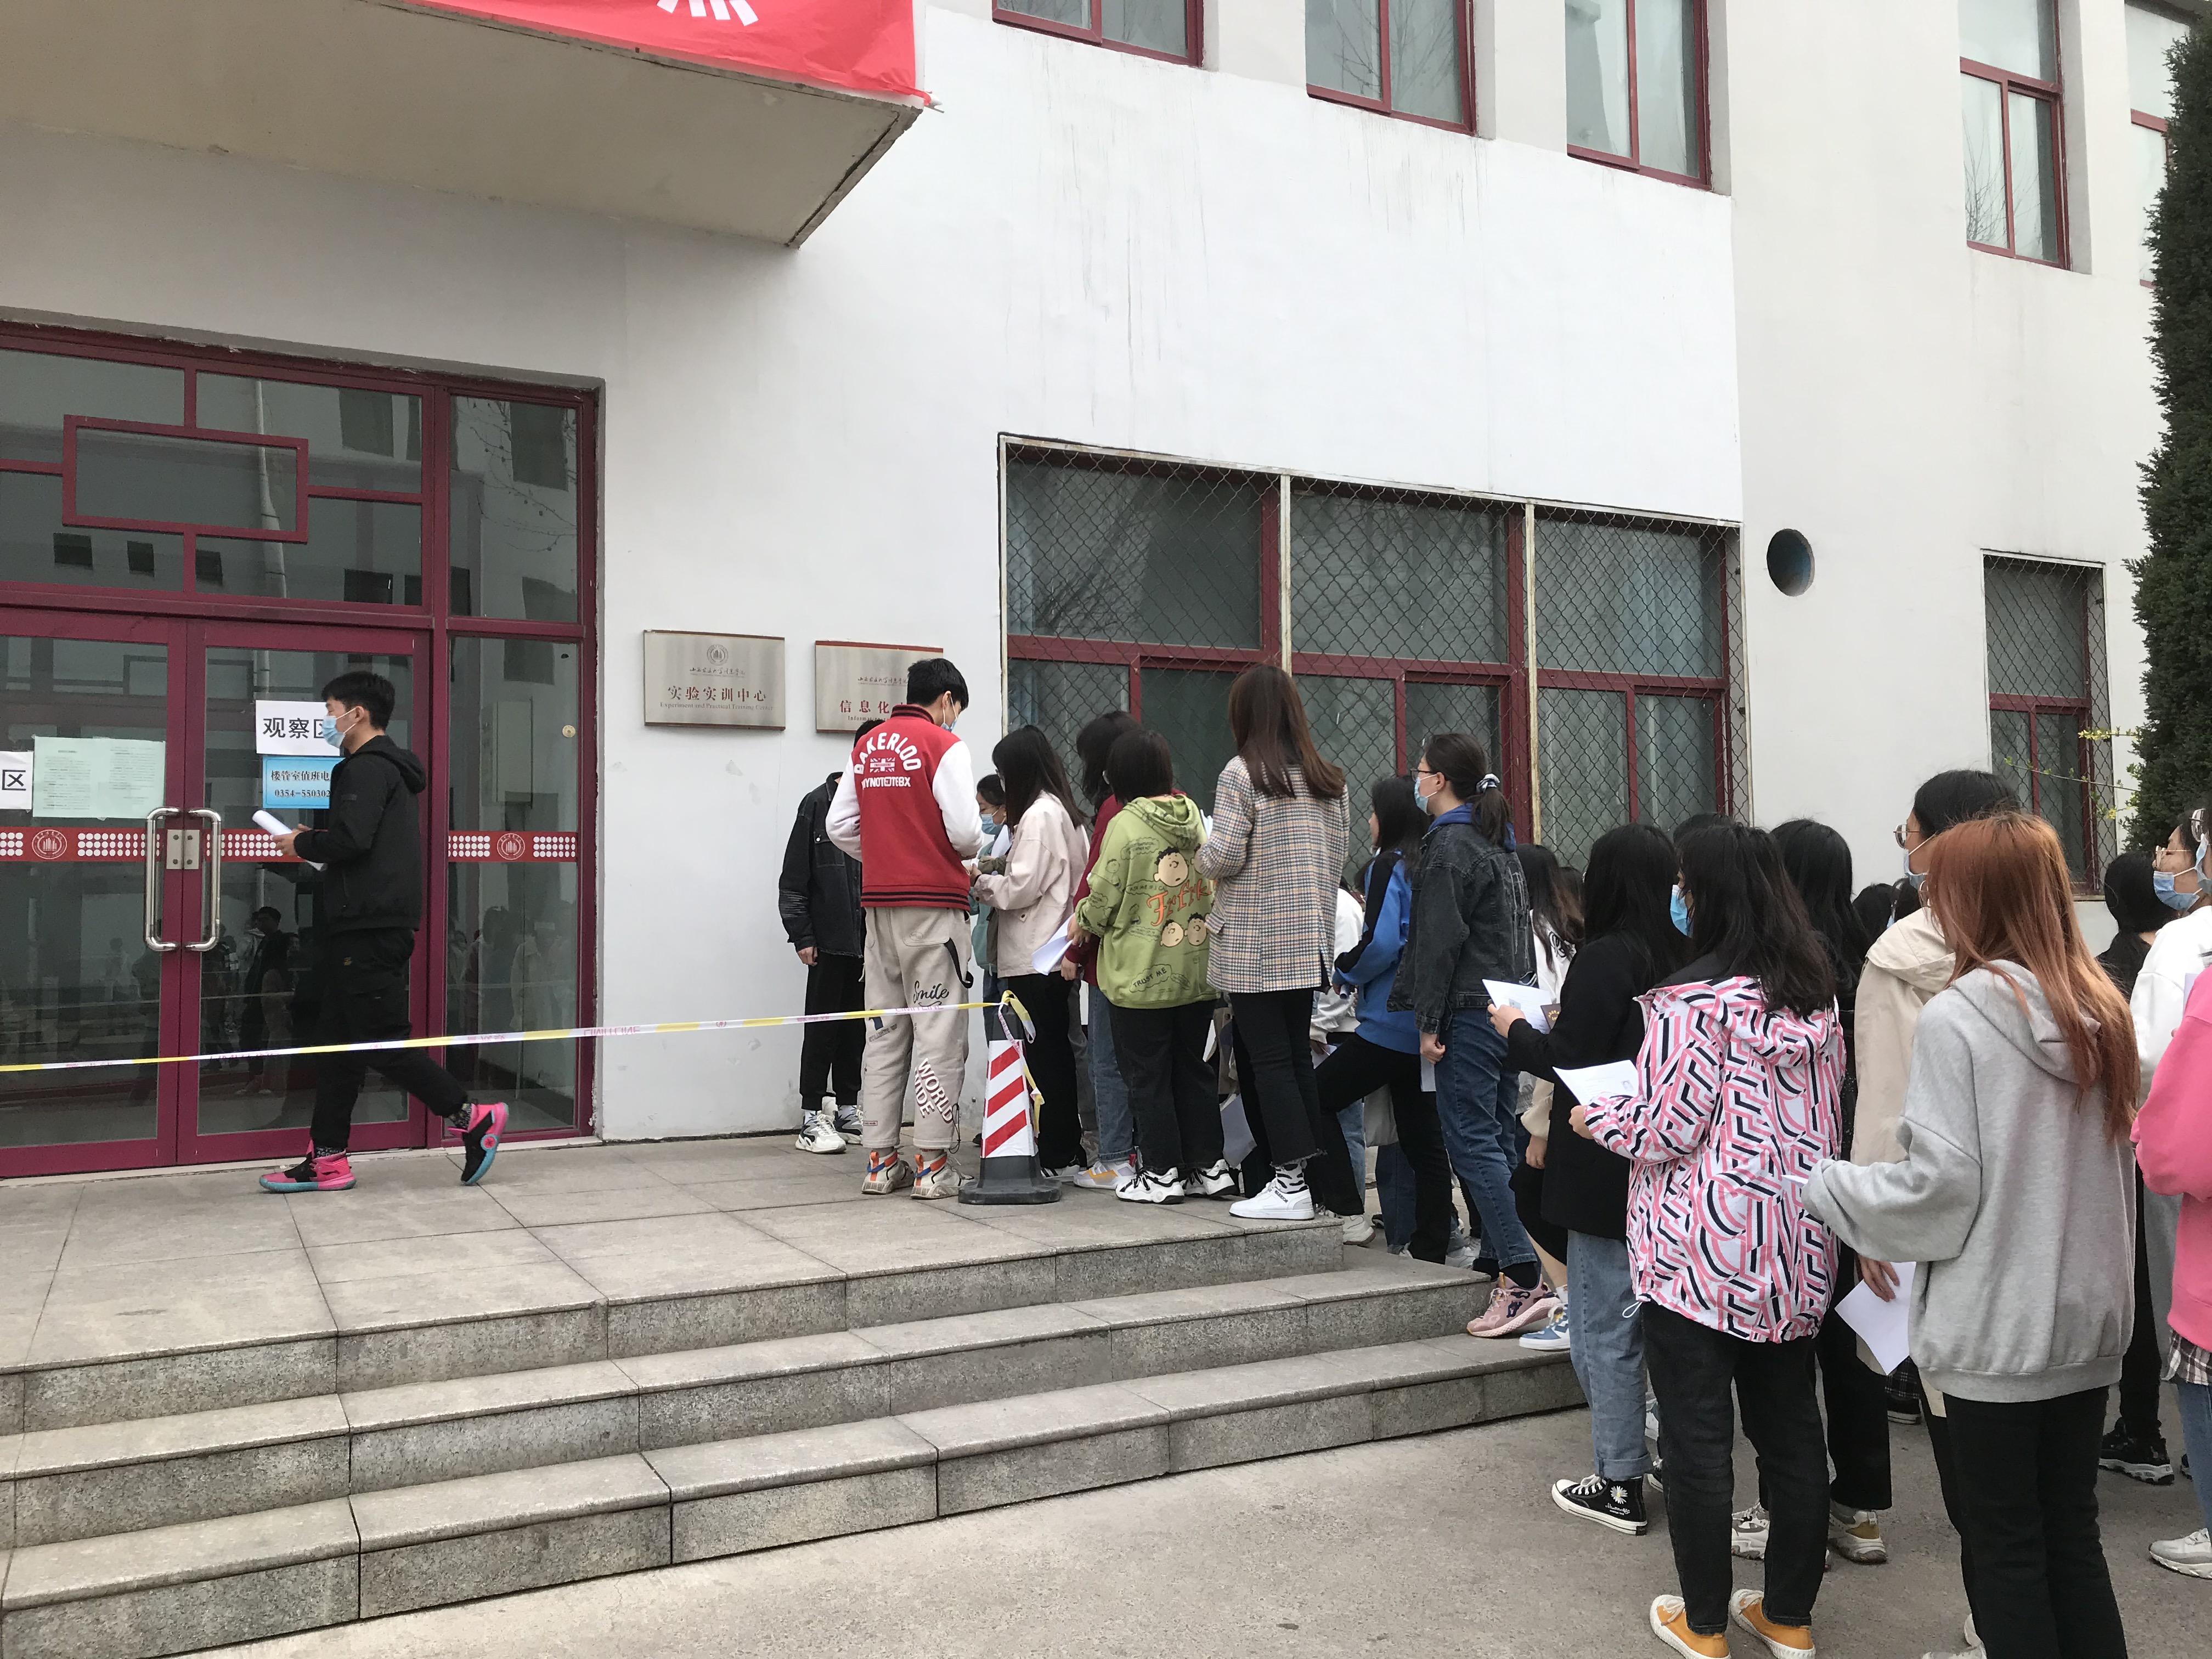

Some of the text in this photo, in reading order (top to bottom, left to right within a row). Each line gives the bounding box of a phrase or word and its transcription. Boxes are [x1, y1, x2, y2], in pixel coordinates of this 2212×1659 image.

[668, 685, 766, 702] 实验实训中心
[840, 699, 903, 714] 信息化
[854, 732, 922, 775] BAKERLOO
[2, 769, 26, 791] 区
[271, 770, 330, 781] 楼管室值班电
[1133, 967, 1167, 988] TRUST ME
[913, 980, 950, 1004] Smile
[918, 1057, 953, 1124] WORLD
